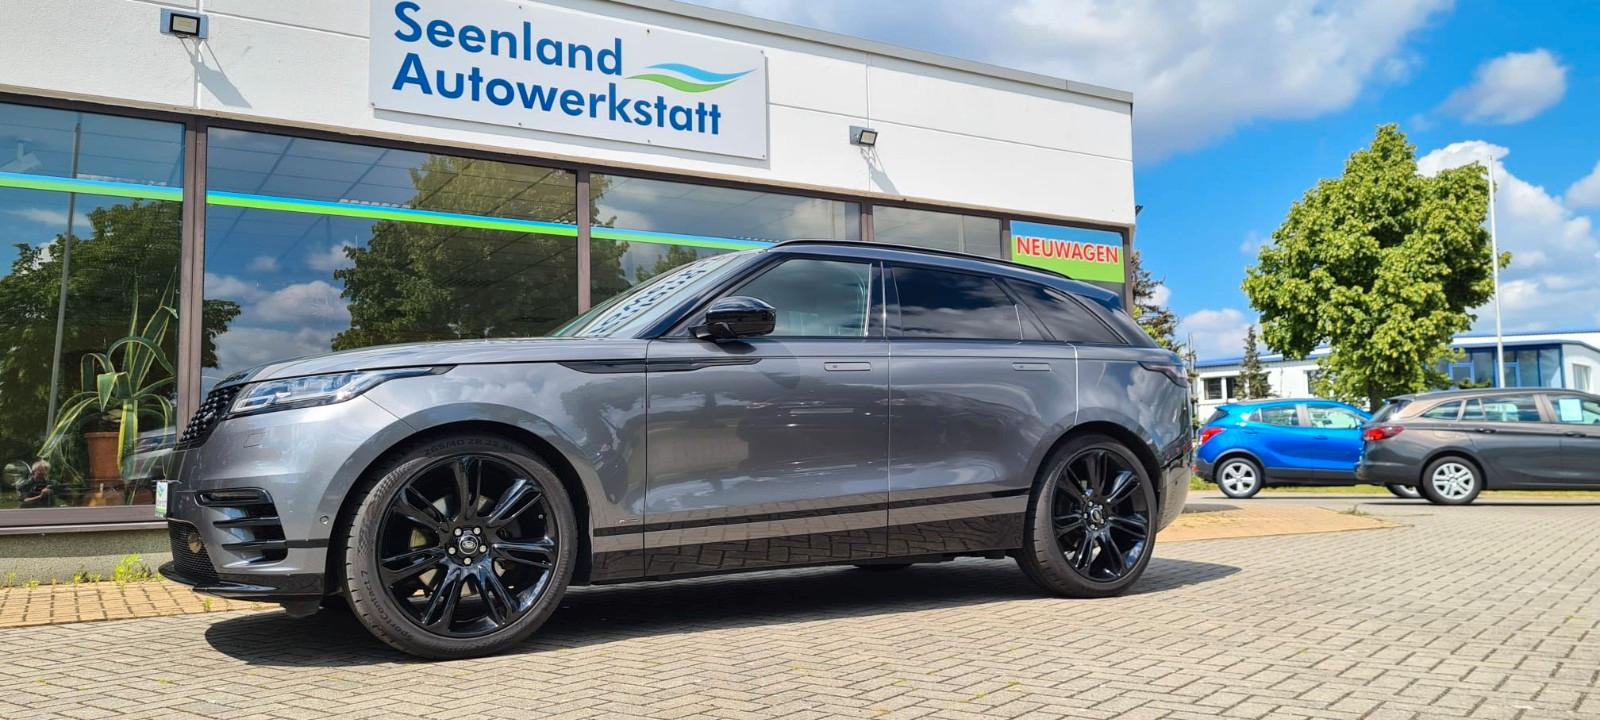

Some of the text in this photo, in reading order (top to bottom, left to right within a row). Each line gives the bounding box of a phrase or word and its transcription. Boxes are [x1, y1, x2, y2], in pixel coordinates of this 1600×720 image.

[394, 1, 623, 76] Seenland
[392, 52, 721, 135] Autowerkstatt
[1016, 236, 1118, 263] NEUWAGEN
